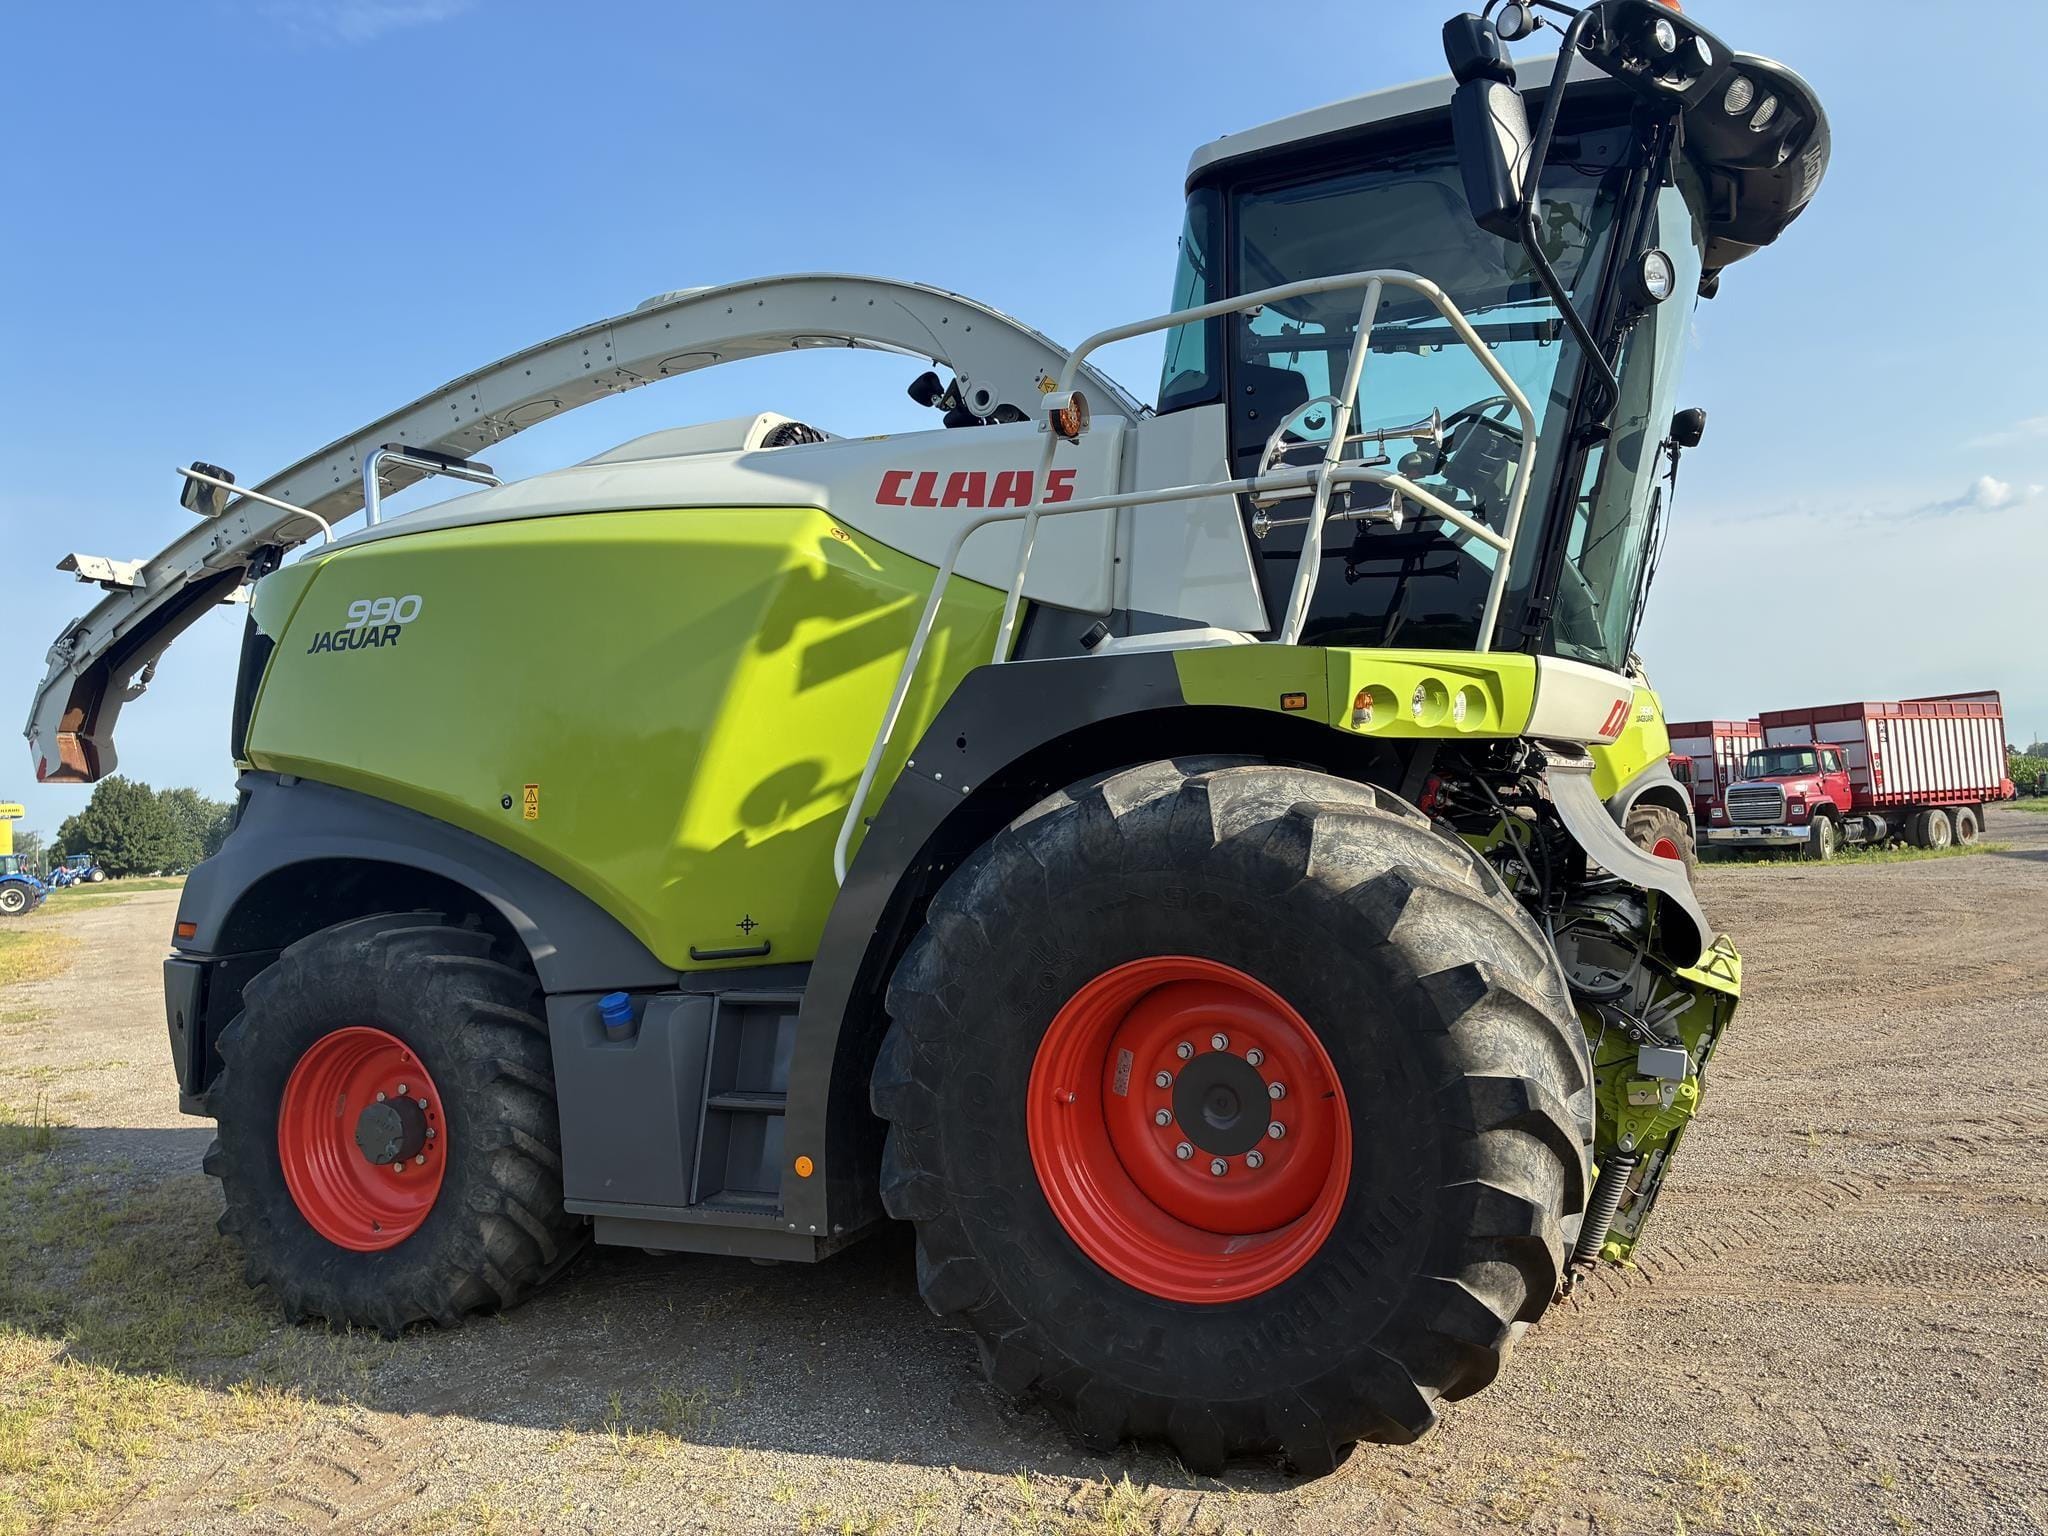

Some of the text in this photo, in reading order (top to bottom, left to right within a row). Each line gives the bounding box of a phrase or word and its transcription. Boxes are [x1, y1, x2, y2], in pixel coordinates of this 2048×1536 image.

[875, 469, 1077, 508] CLAAS
[345, 595, 423, 629] 990
[306, 625, 402, 654] JAGUAR
[1636, 715, 1654, 723] JAGUAR
